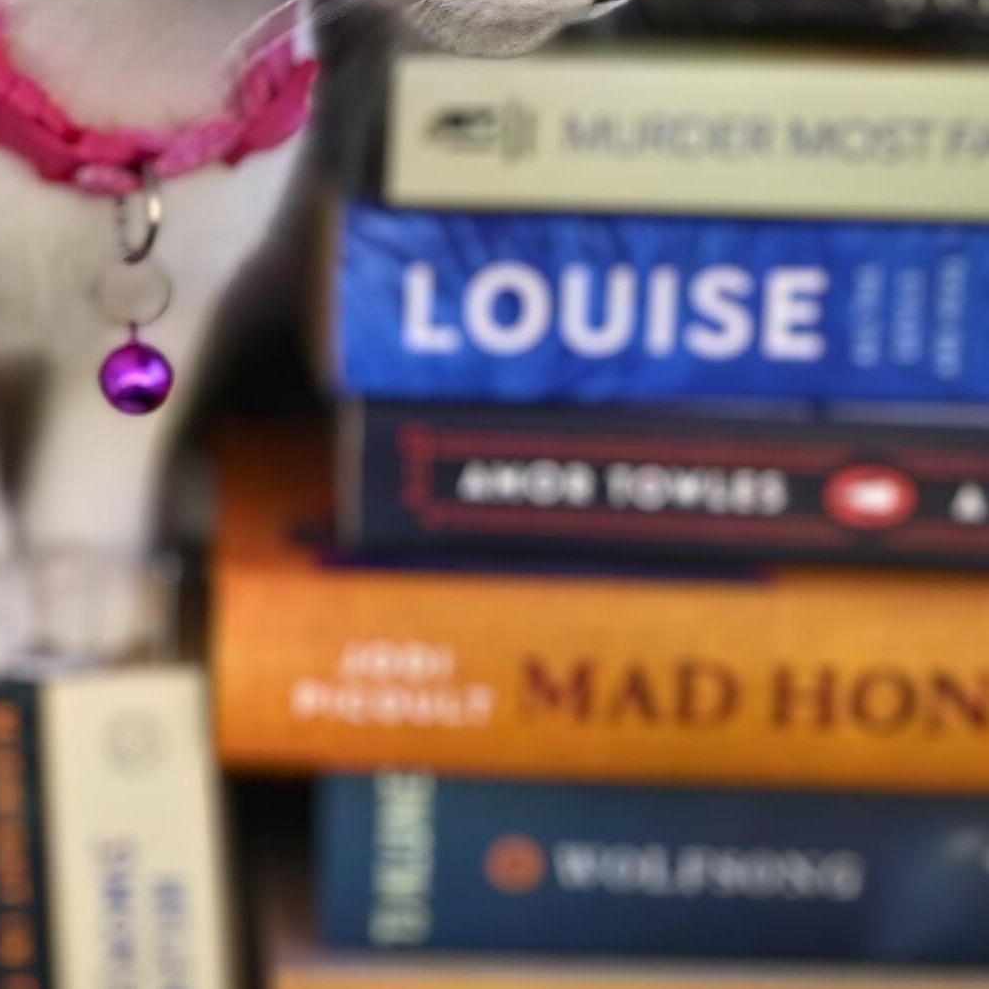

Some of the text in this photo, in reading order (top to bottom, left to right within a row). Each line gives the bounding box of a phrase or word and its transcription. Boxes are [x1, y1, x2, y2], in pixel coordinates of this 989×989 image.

[563, 113, 775, 156] MURDER
[787, 117, 935, 162] MOST
[402, 260, 827, 361] LOUISE
[456, 457, 597, 506] AMOR
[607, 462, 788, 515] TOWLES
[521, 656, 989, 740] MAD HON
[553, 840, 868, 902] WOLFSONG
